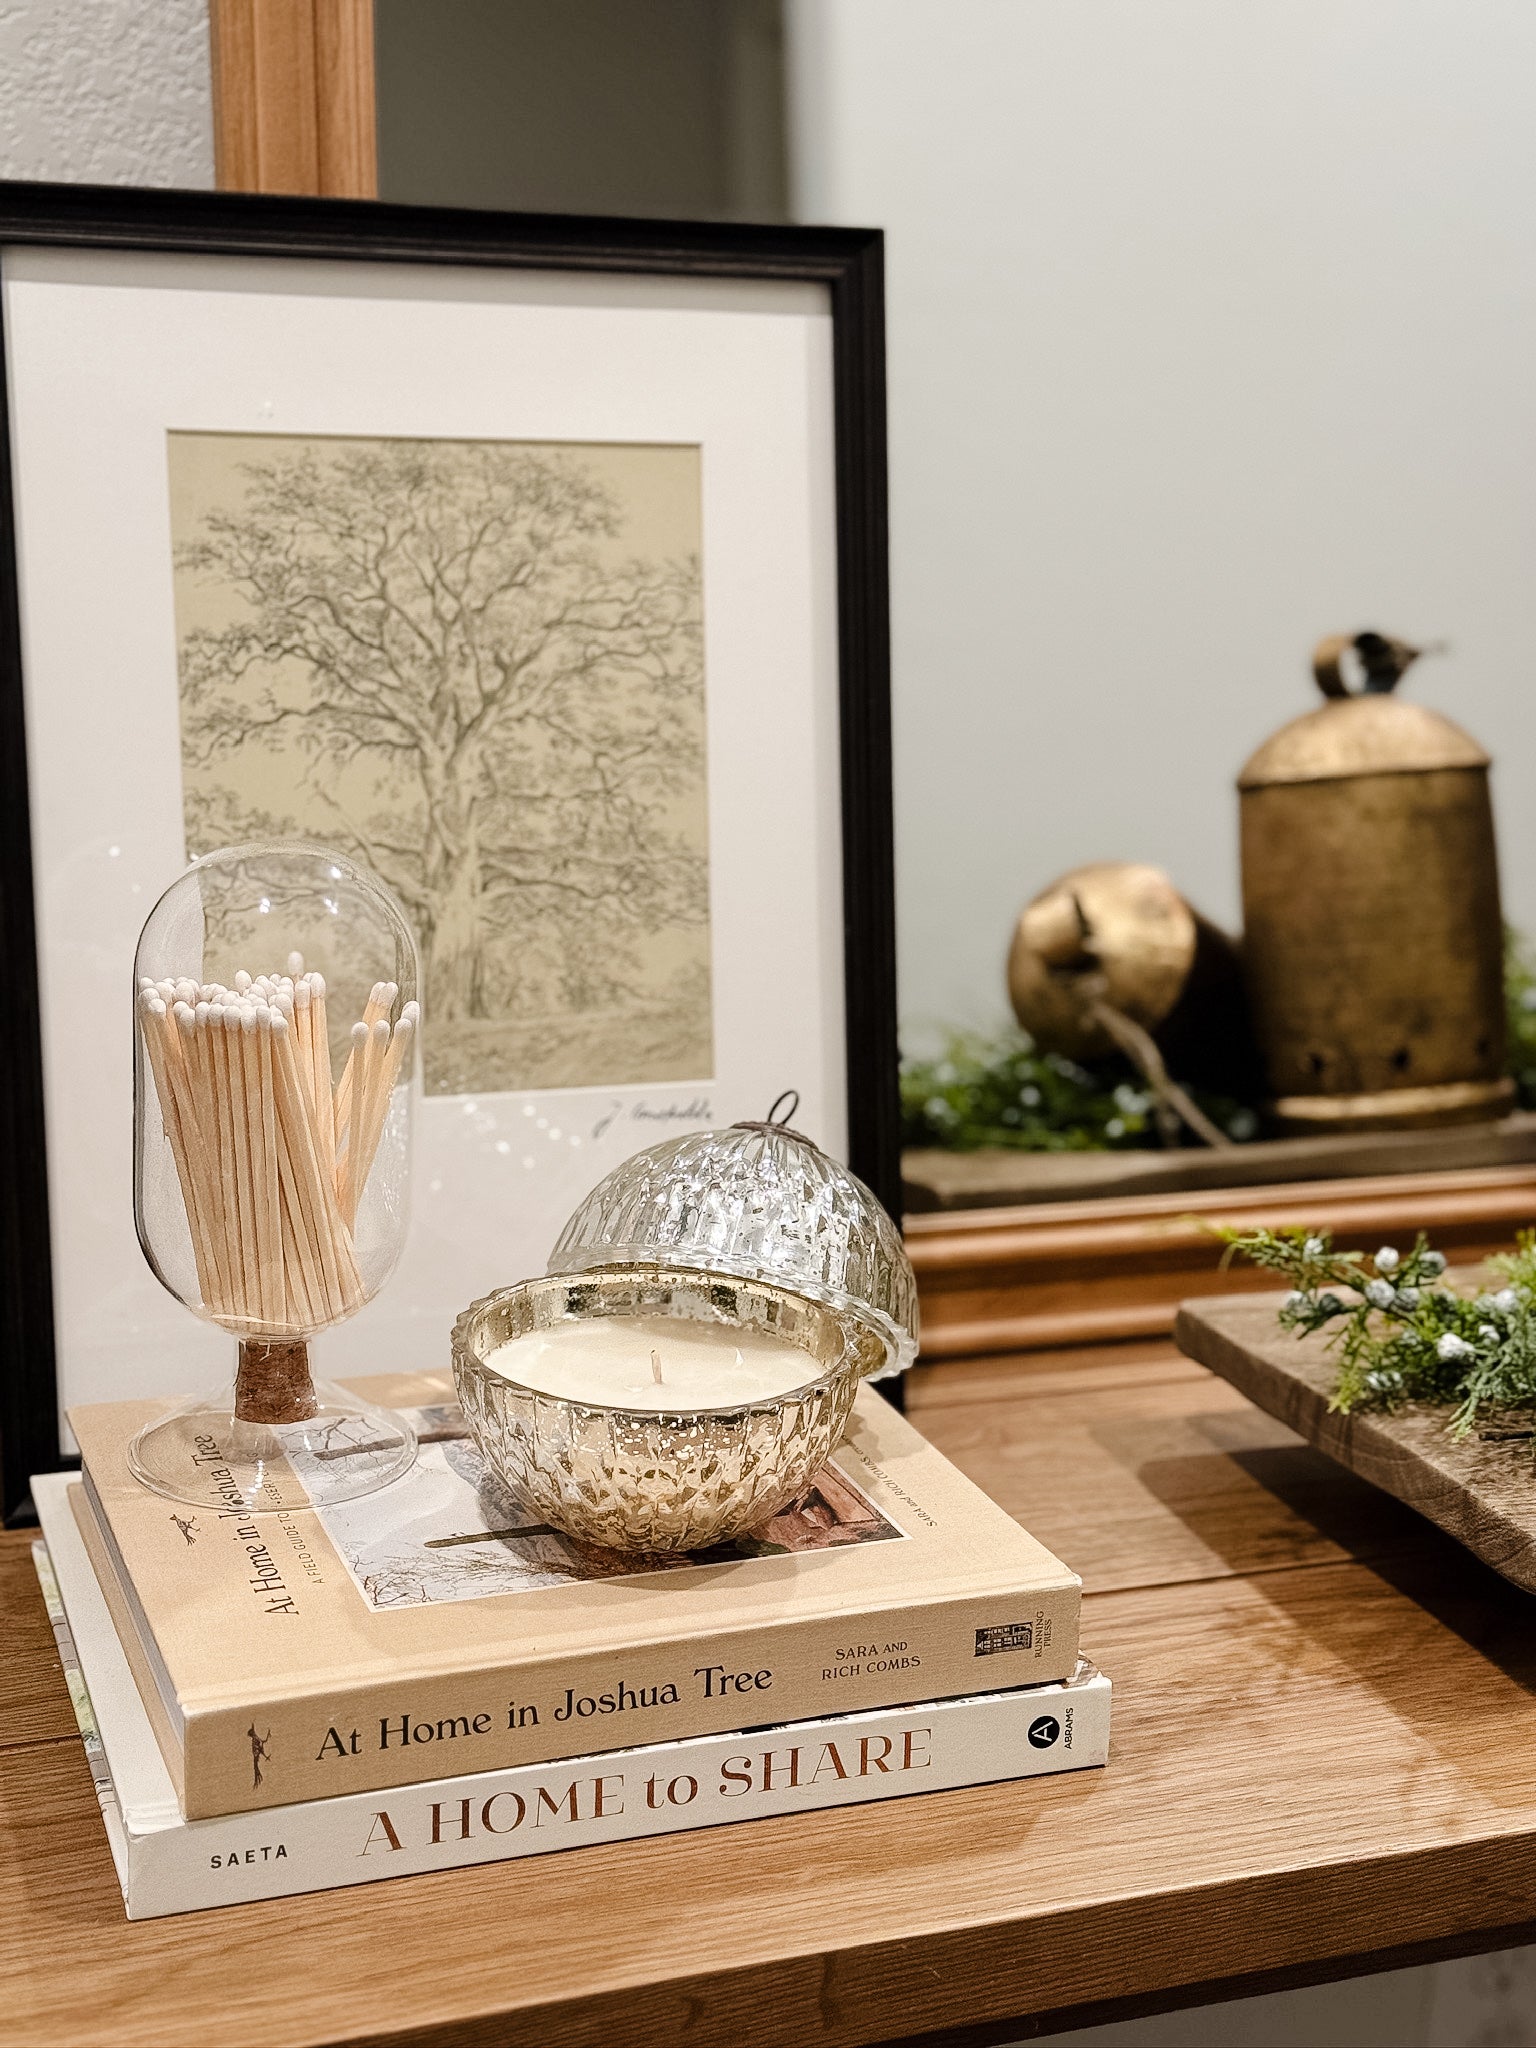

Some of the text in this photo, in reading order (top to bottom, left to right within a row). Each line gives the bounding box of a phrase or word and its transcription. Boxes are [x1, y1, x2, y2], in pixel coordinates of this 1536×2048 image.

[191, 1434, 224, 1466] Tree
[277, 1512, 292, 1524] TO
[232, 1525, 261, 1541] in
[283, 1525, 306, 1550] GUIDE
[245, 1543, 287, 1593] Home
[298, 1553, 321, 1577] FIELD
[264, 1595, 300, 1616] At
[1034, 1610, 1045, 1659] RUNNING
[1044, 1618, 1053, 1648] PRESS
[834, 1640, 909, 1662] SARA AND
[821, 1655, 922, 1681] RICH COMBS
[314, 1665, 774, 1761] At Home in Joshua Tree
[1063, 1707, 1074, 1750] ABRAMS
[355, 1727, 933, 1857] A HOME to SHARE
[210, 1844, 289, 1869] SAETA
